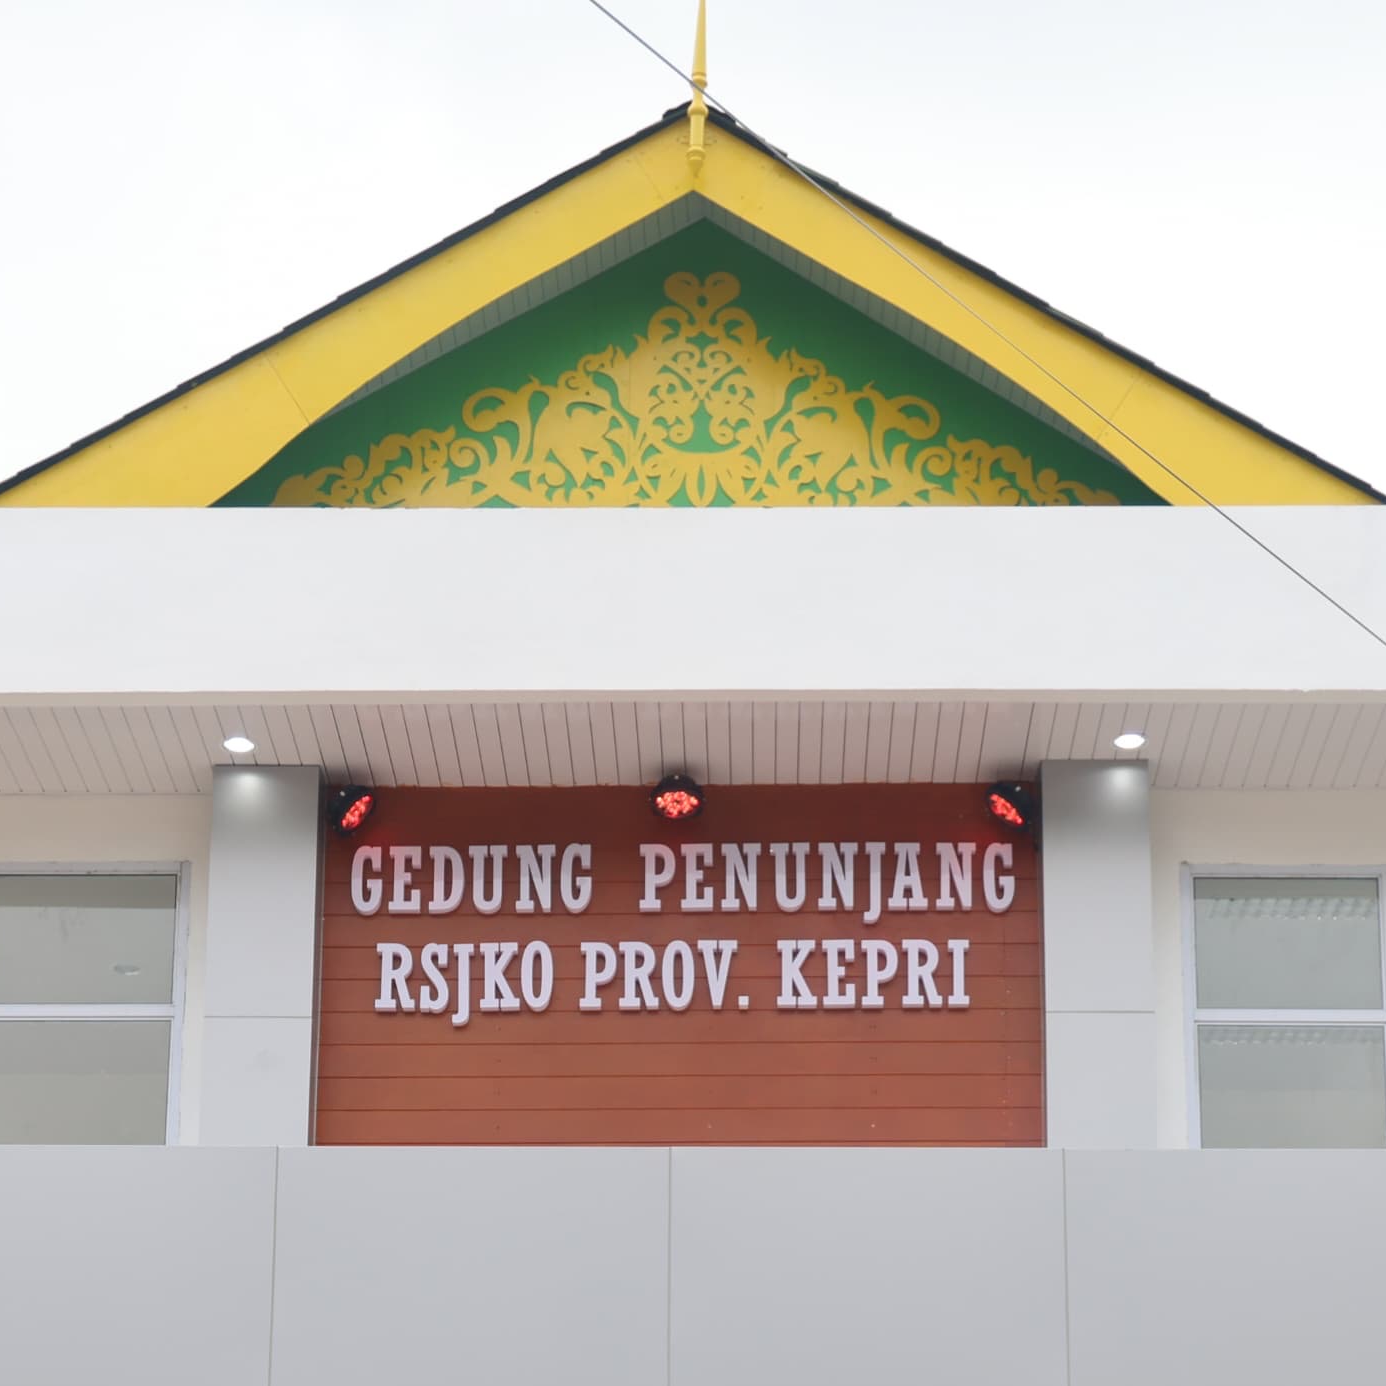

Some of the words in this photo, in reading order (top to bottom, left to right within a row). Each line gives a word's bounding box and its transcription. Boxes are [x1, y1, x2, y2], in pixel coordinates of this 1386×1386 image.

[351, 843, 592, 916] GEDUNG
[639, 842, 1015, 924] PENUNJANG
[374, 940, 554, 1027] RSJKO
[579, 939, 749, 1011] PROV.
[776, 939, 970, 1008] KEPRI
